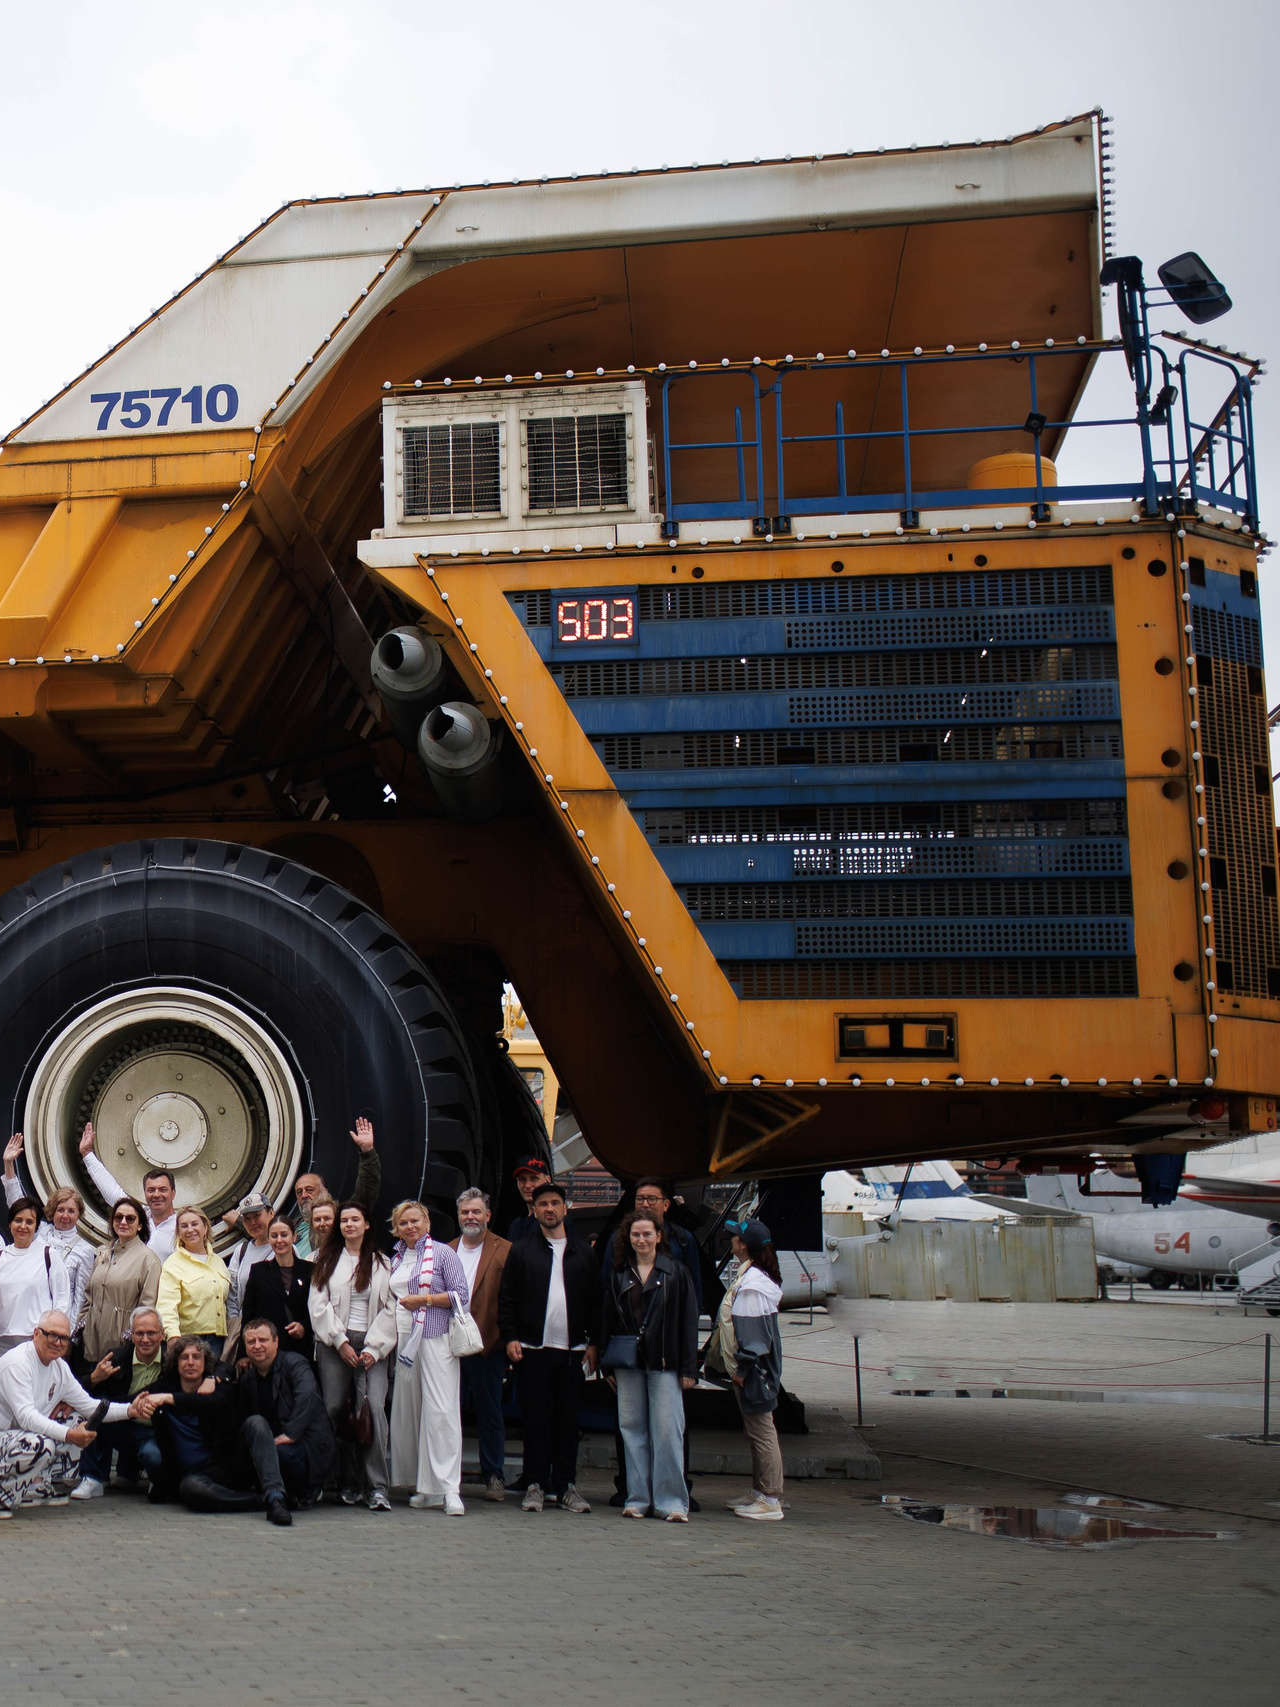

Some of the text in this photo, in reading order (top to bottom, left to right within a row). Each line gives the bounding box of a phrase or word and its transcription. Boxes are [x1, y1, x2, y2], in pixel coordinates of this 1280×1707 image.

[90, 383, 239, 431] 75710
[558, 599, 633, 641] 503
[1154, 1231, 1191, 1255] 54
